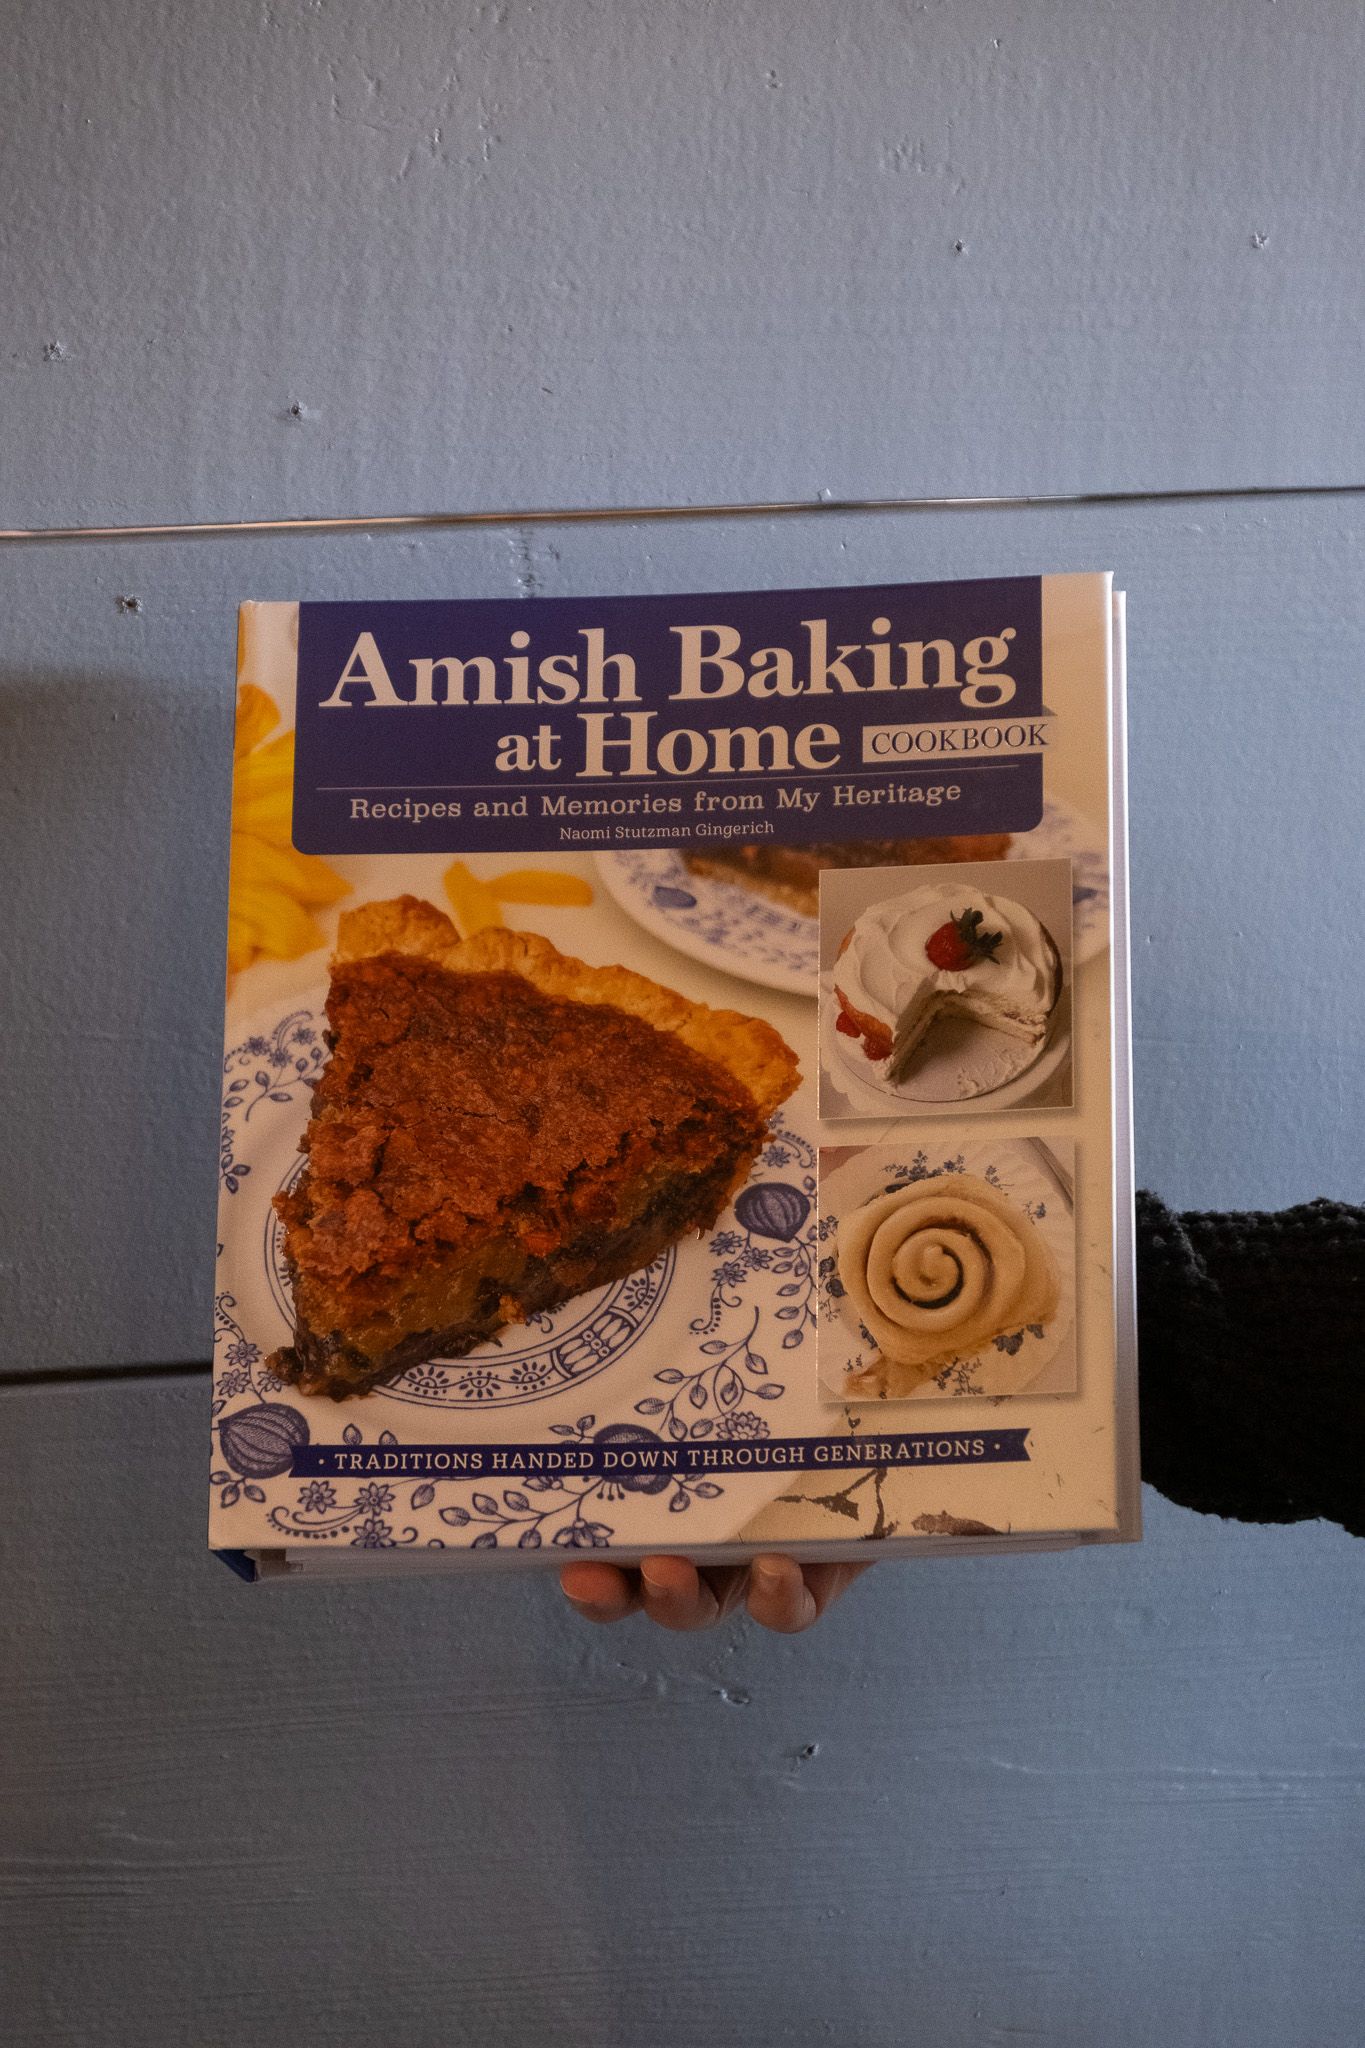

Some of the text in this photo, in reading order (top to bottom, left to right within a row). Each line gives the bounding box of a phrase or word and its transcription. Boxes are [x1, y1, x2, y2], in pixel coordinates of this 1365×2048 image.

[318, 617, 1017, 708] Amish Baking
[494, 711, 841, 777] at Home
[871, 723, 1049, 755] COOKBOOK
[350, 782, 962, 823] Recipes and Memories from My Heritage
[559, 821, 774, 840] Naomi Stutzman Gingerich
[334, 1439, 985, 1470] TRADITIONS HANDED DOWN THROUGH GENERATIONS
